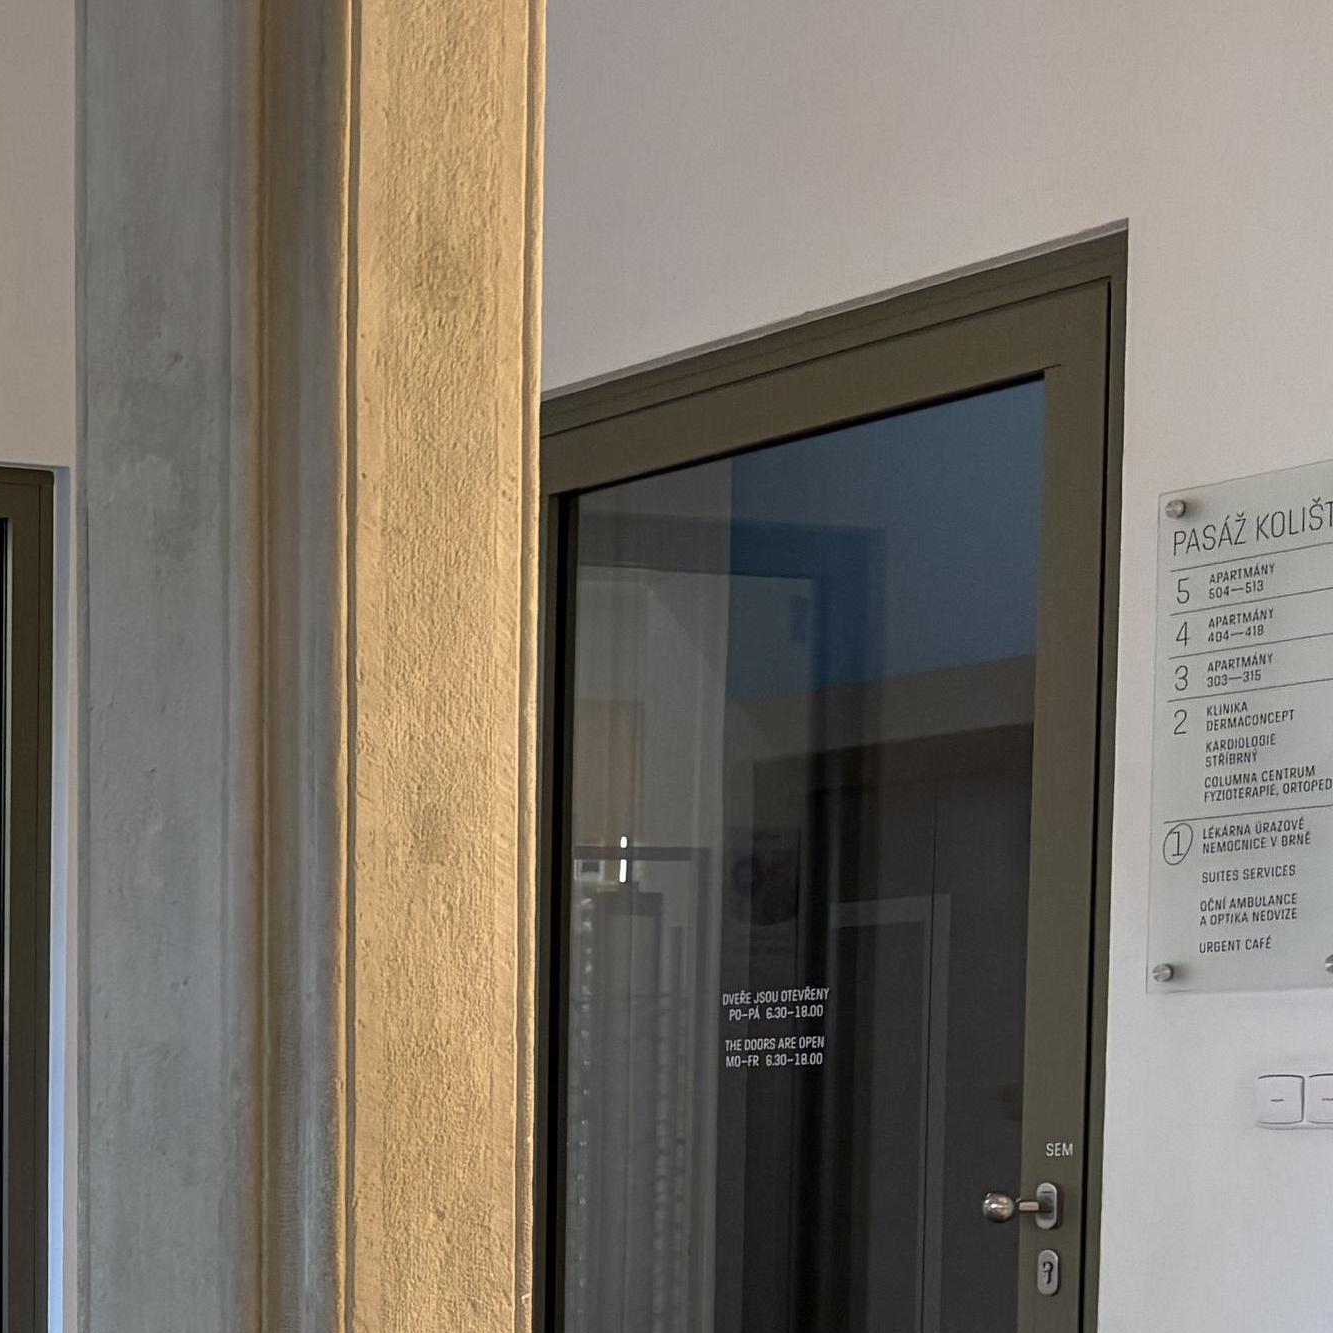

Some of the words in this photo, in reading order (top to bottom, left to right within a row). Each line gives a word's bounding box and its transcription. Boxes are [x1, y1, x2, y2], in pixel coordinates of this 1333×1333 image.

[1173, 512, 1246, 556] PASÁŽ
[1209, 563, 1274, 584] APARTMÁNY
[1177, 578, 1189, 604] 5
[1209, 608, 1274, 628] APARTMÁNY
[1176, 621, 1189, 647] 4
[1208, 653, 1273, 672] APARTMÁNY
[1175, 665, 1188, 691] 3
[1207, 701, 1248, 717] KLINIKA
[1174, 710, 1187, 735] 2
[1207, 709, 1294, 731] DERMACONCEPT
[1206, 733, 1276, 752] KARDIOLOGIE
[1205, 748, 1257, 767] STŘÍBRNÝ
[1205, 773, 1257, 788] COLUMNA
[1262, 765, 1315, 782] CENTRUM
[1204, 786, 1279, 802] FYZIOTERAPIE,
[1203, 823, 1250, 839] LÉKÁRNA
[1256, 817, 1304, 834] ÚRAZOVÉ
[1172, 831, 1183, 856] 1
[1203, 837, 1266, 854] NEMOCNICE
[1271, 837, 1277, 847] V
[1282, 832, 1311, 846] BRNĚ
[1202, 870, 1238, 883] SUITES
[1243, 865, 1296, 880] SERVICES
[1200, 896, 1225, 912] OČNÍ
[1229, 893, 1298, 909] AMBULANCE
[1200, 916, 1206, 926] A
[1210, 913, 1248, 925] OPTIKA
[1253, 908, 1297, 922] NEOVIZE
[1199, 940, 1241, 953] URGENT
[1246, 935, 1271, 950] CAFÉ
[723, 990, 751, 1005] DVEŘE
[753, 990, 778, 1003] JSOU
[781, 986, 829, 1002] OTEVŘENY
[725, 1039, 742, 1051] THE
[745, 1038, 775, 1051] DOORS
[778, 1038, 796, 1049] ARE
[799, 1036, 824, 1048] OPEN
[1046, 1143, 1073, 1157] SEM
